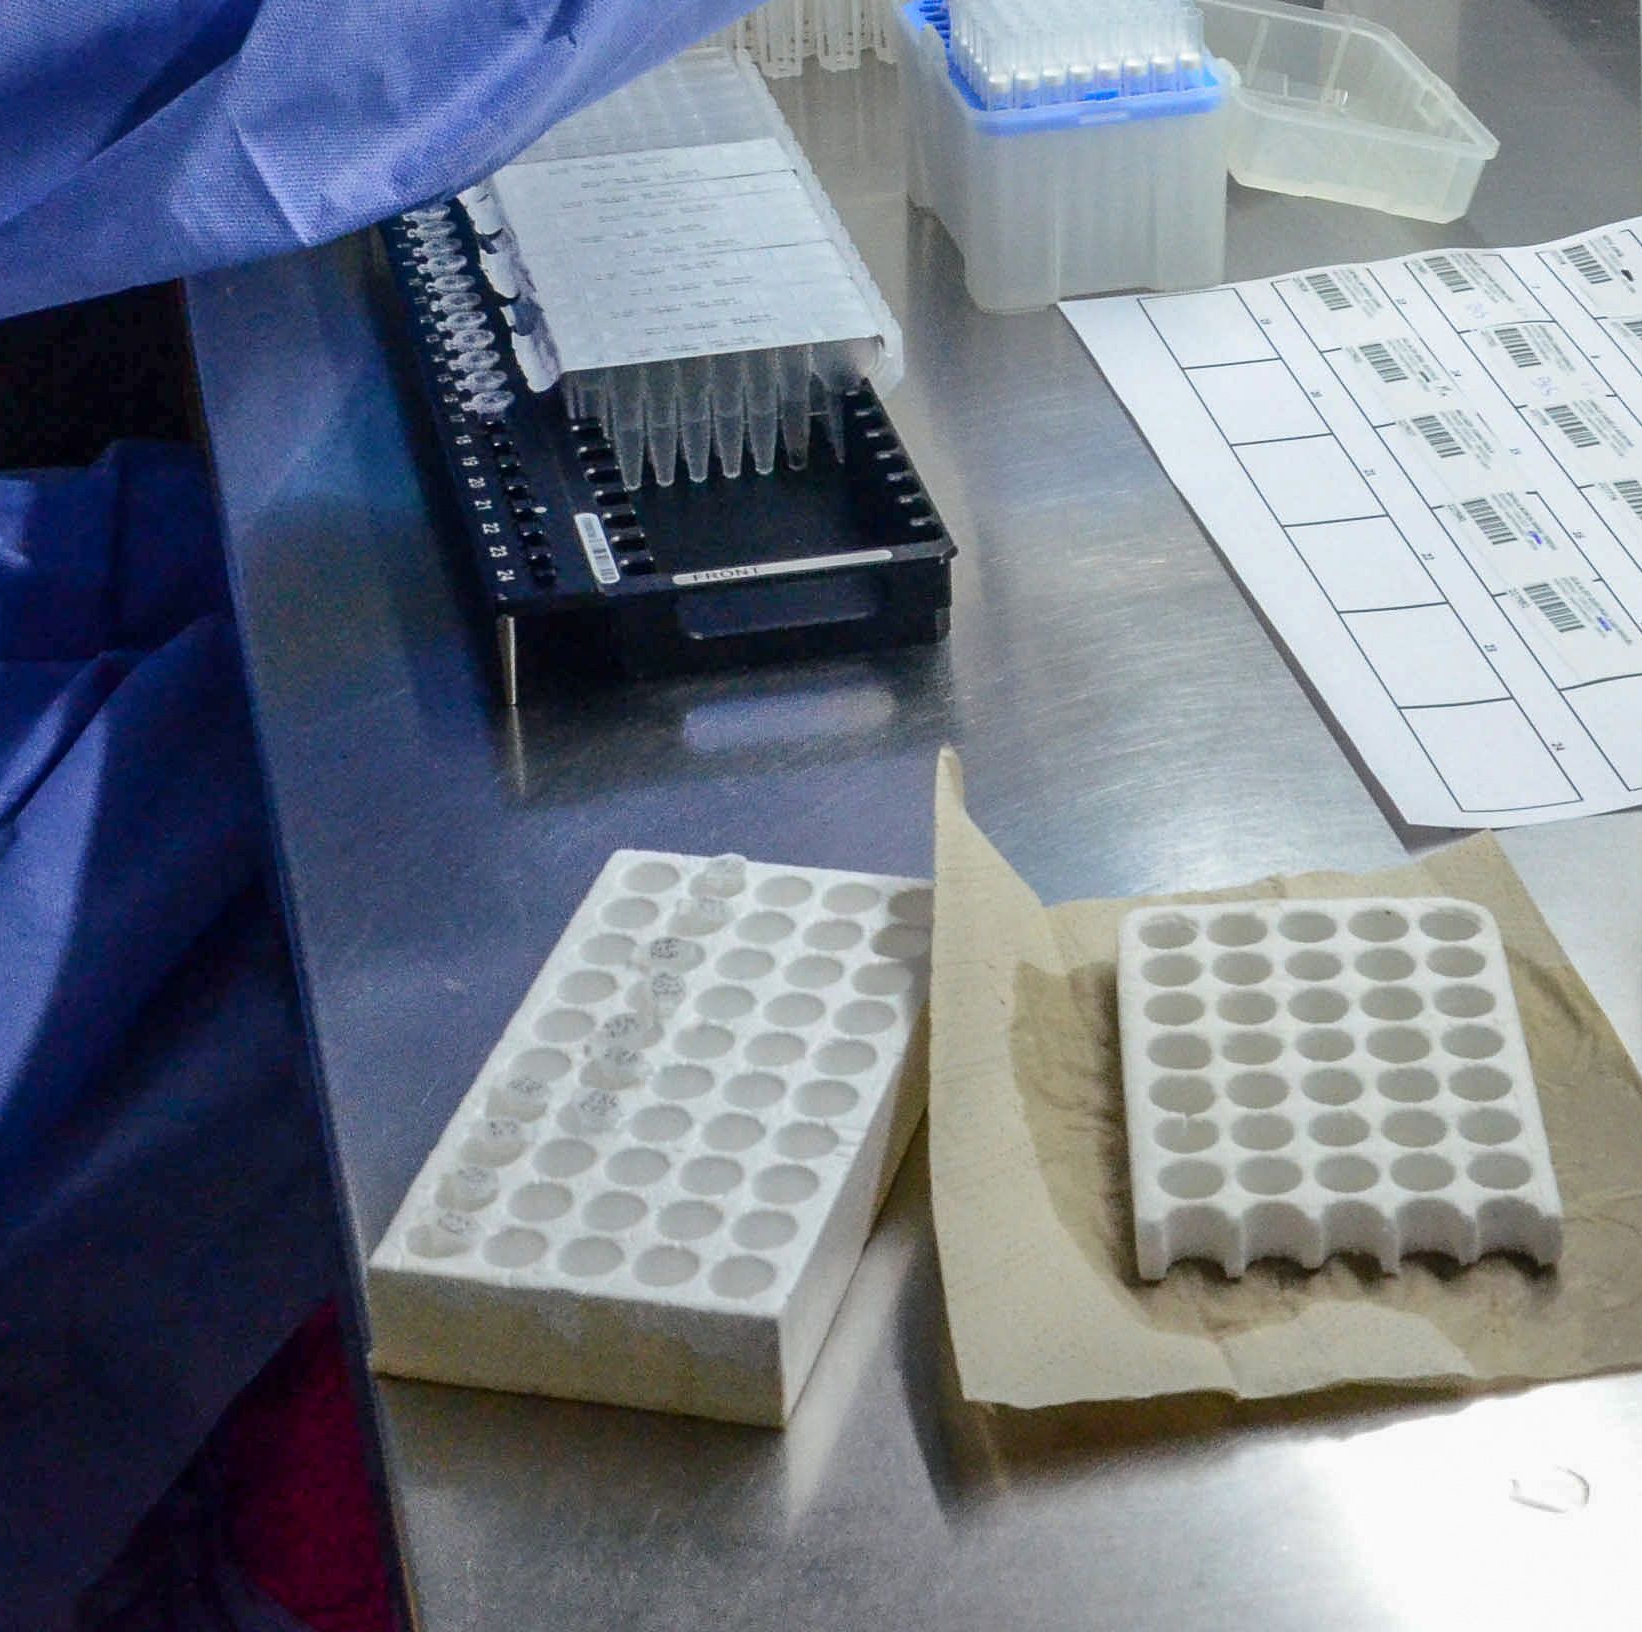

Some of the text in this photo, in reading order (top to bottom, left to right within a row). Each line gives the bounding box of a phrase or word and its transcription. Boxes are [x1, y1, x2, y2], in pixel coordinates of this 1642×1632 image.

[461, 456, 479, 467] 19
[468, 476, 486, 489] 20
[474, 499, 493, 511] 21
[481, 522, 501, 535] 22
[489, 544, 508, 558] 23
[496, 568, 517, 582] 24
